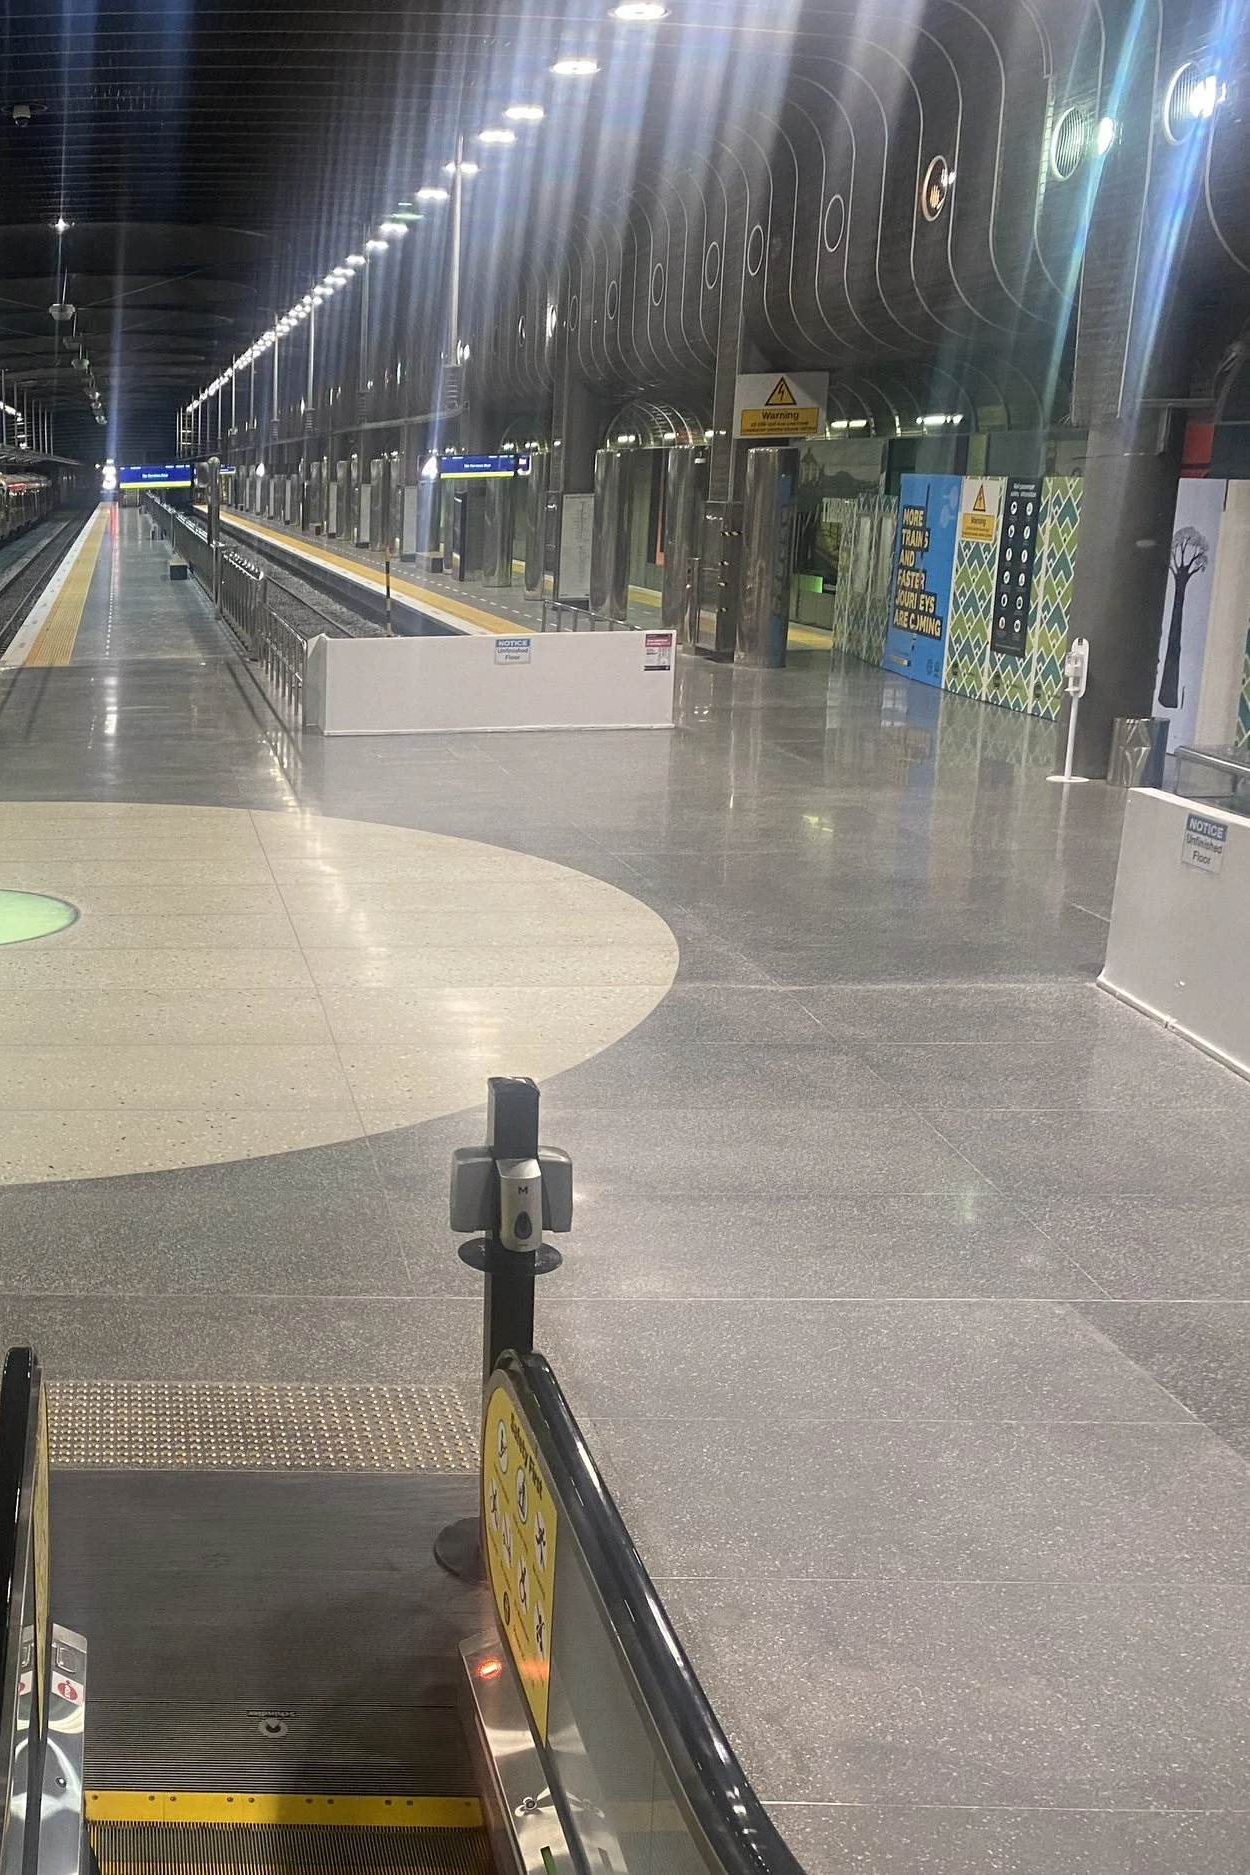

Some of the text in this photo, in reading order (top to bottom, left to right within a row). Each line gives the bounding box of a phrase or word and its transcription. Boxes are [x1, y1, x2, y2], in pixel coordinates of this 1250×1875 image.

[761, 411, 799, 421] Warning
[902, 508, 924, 527] MORE
[902, 528, 929, 549] TRAINS
[899, 549, 915, 567] AND
[897, 568, 925, 590] FASTER
[893, 609, 909, 628] ARE
[1189, 818, 1224, 839] NOTICE
[1186, 832, 1223, 854] Unfinished
[1192, 850, 1211, 864] Floor
[518, 1186, 529, 1195] M
